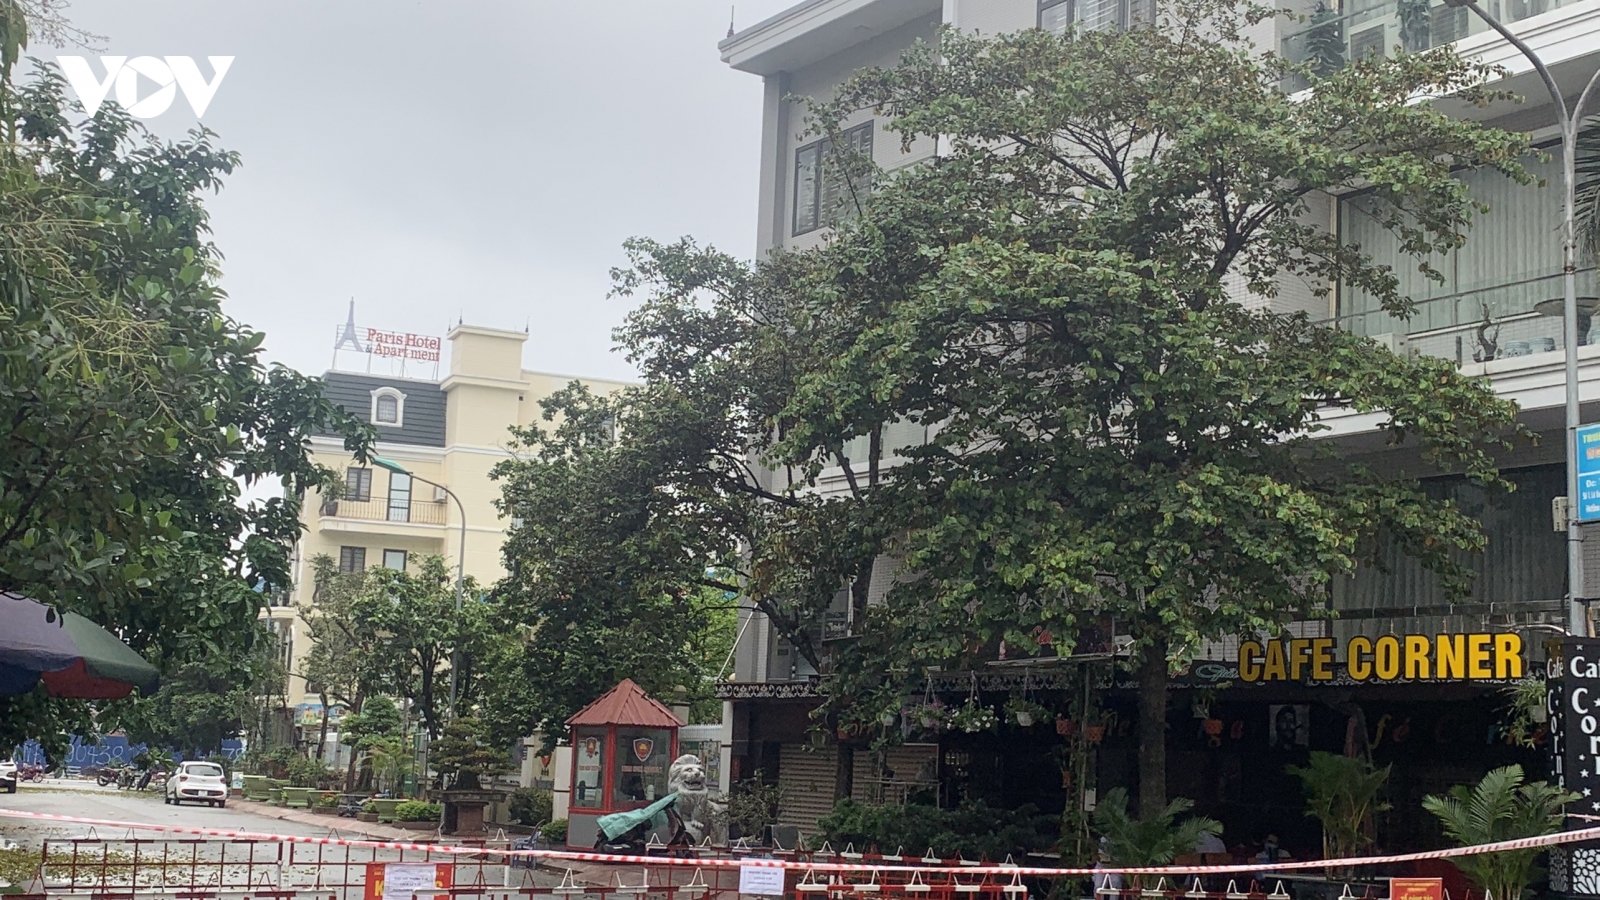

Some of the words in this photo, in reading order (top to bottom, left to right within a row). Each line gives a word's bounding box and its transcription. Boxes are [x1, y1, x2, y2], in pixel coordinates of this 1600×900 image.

[367, 328, 403, 345] Paris
[405, 333, 441, 350] Hotel
[1239, 638, 1333, 682] CAFE
[1347, 633, 1522, 681] CORNER
[1570, 655, 1600, 678] Ca
